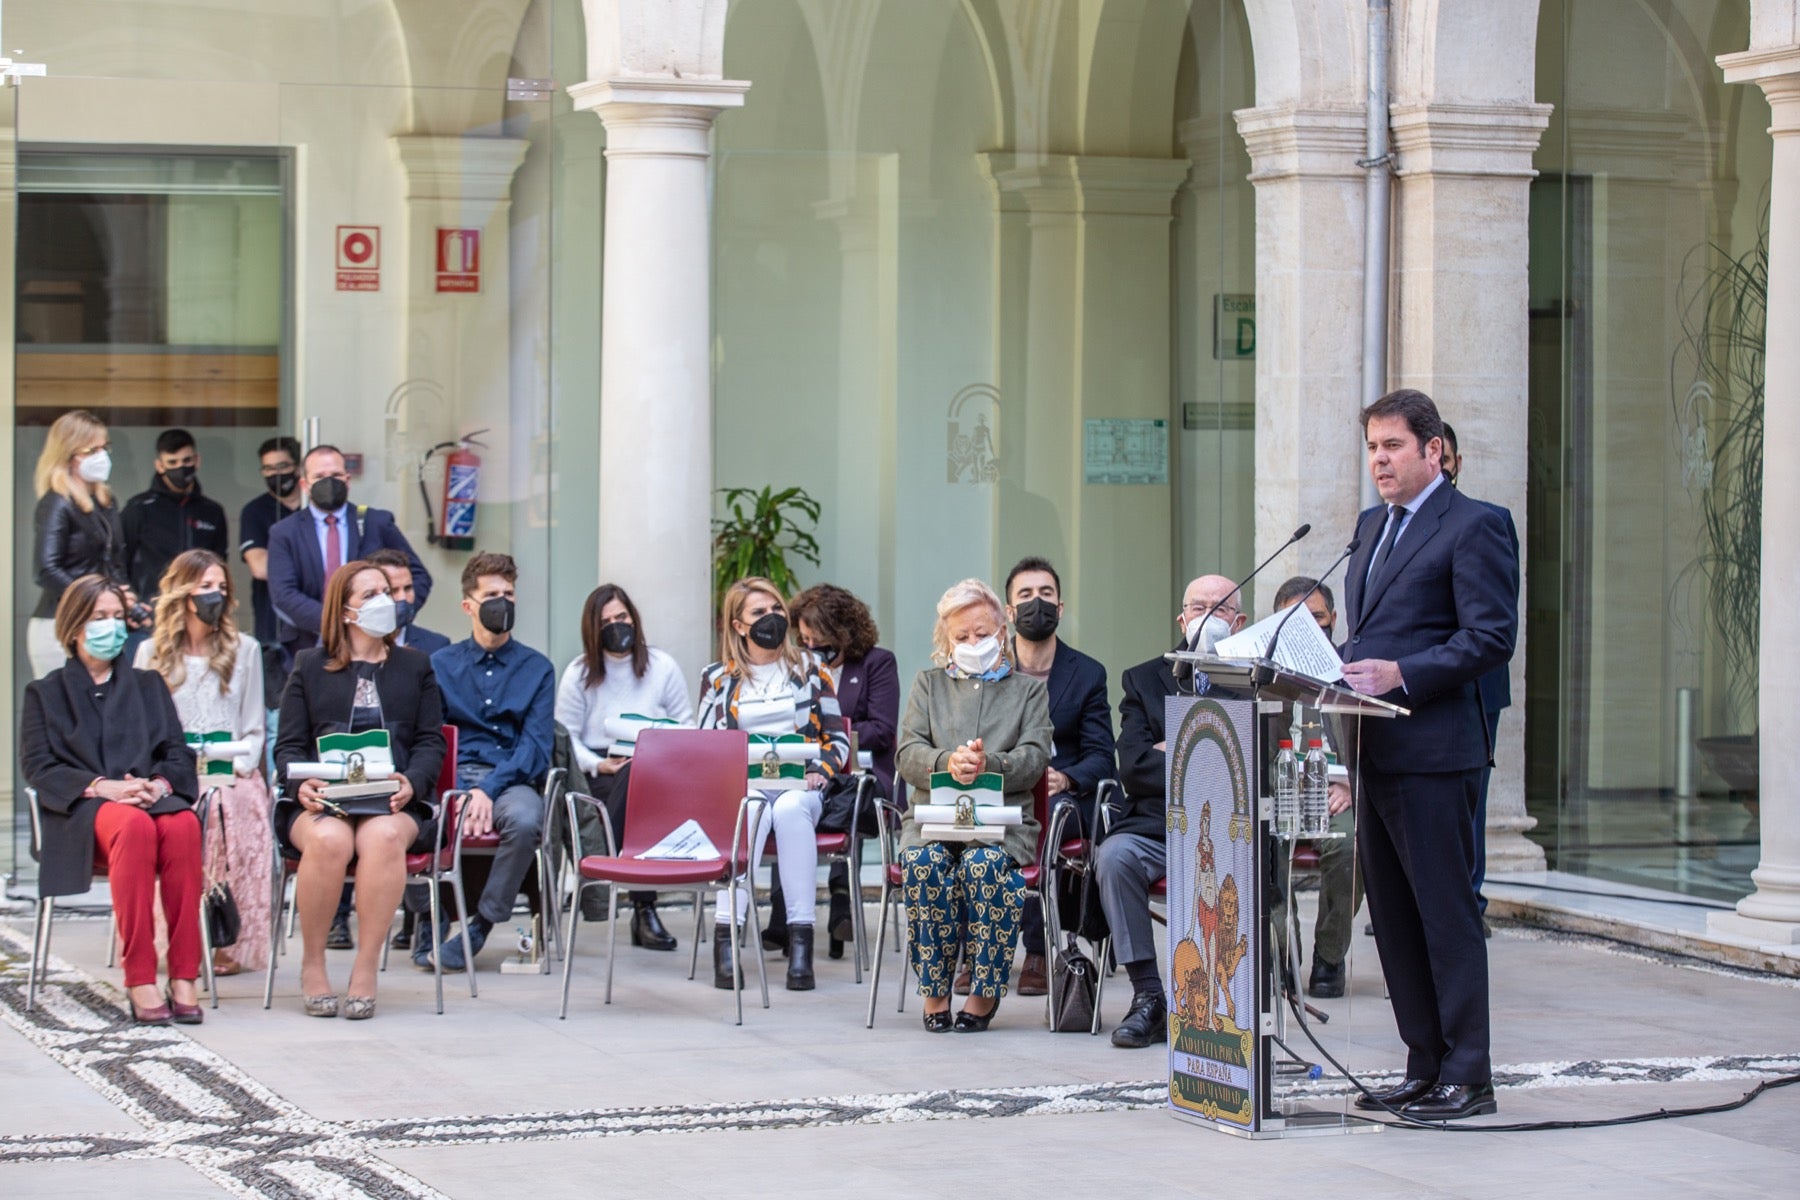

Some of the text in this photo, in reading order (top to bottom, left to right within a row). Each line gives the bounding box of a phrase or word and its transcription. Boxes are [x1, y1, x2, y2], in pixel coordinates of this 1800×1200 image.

[1236, 318, 1256, 355] D
[1187, 1056, 1233, 1083] PARA ESPAÑA
